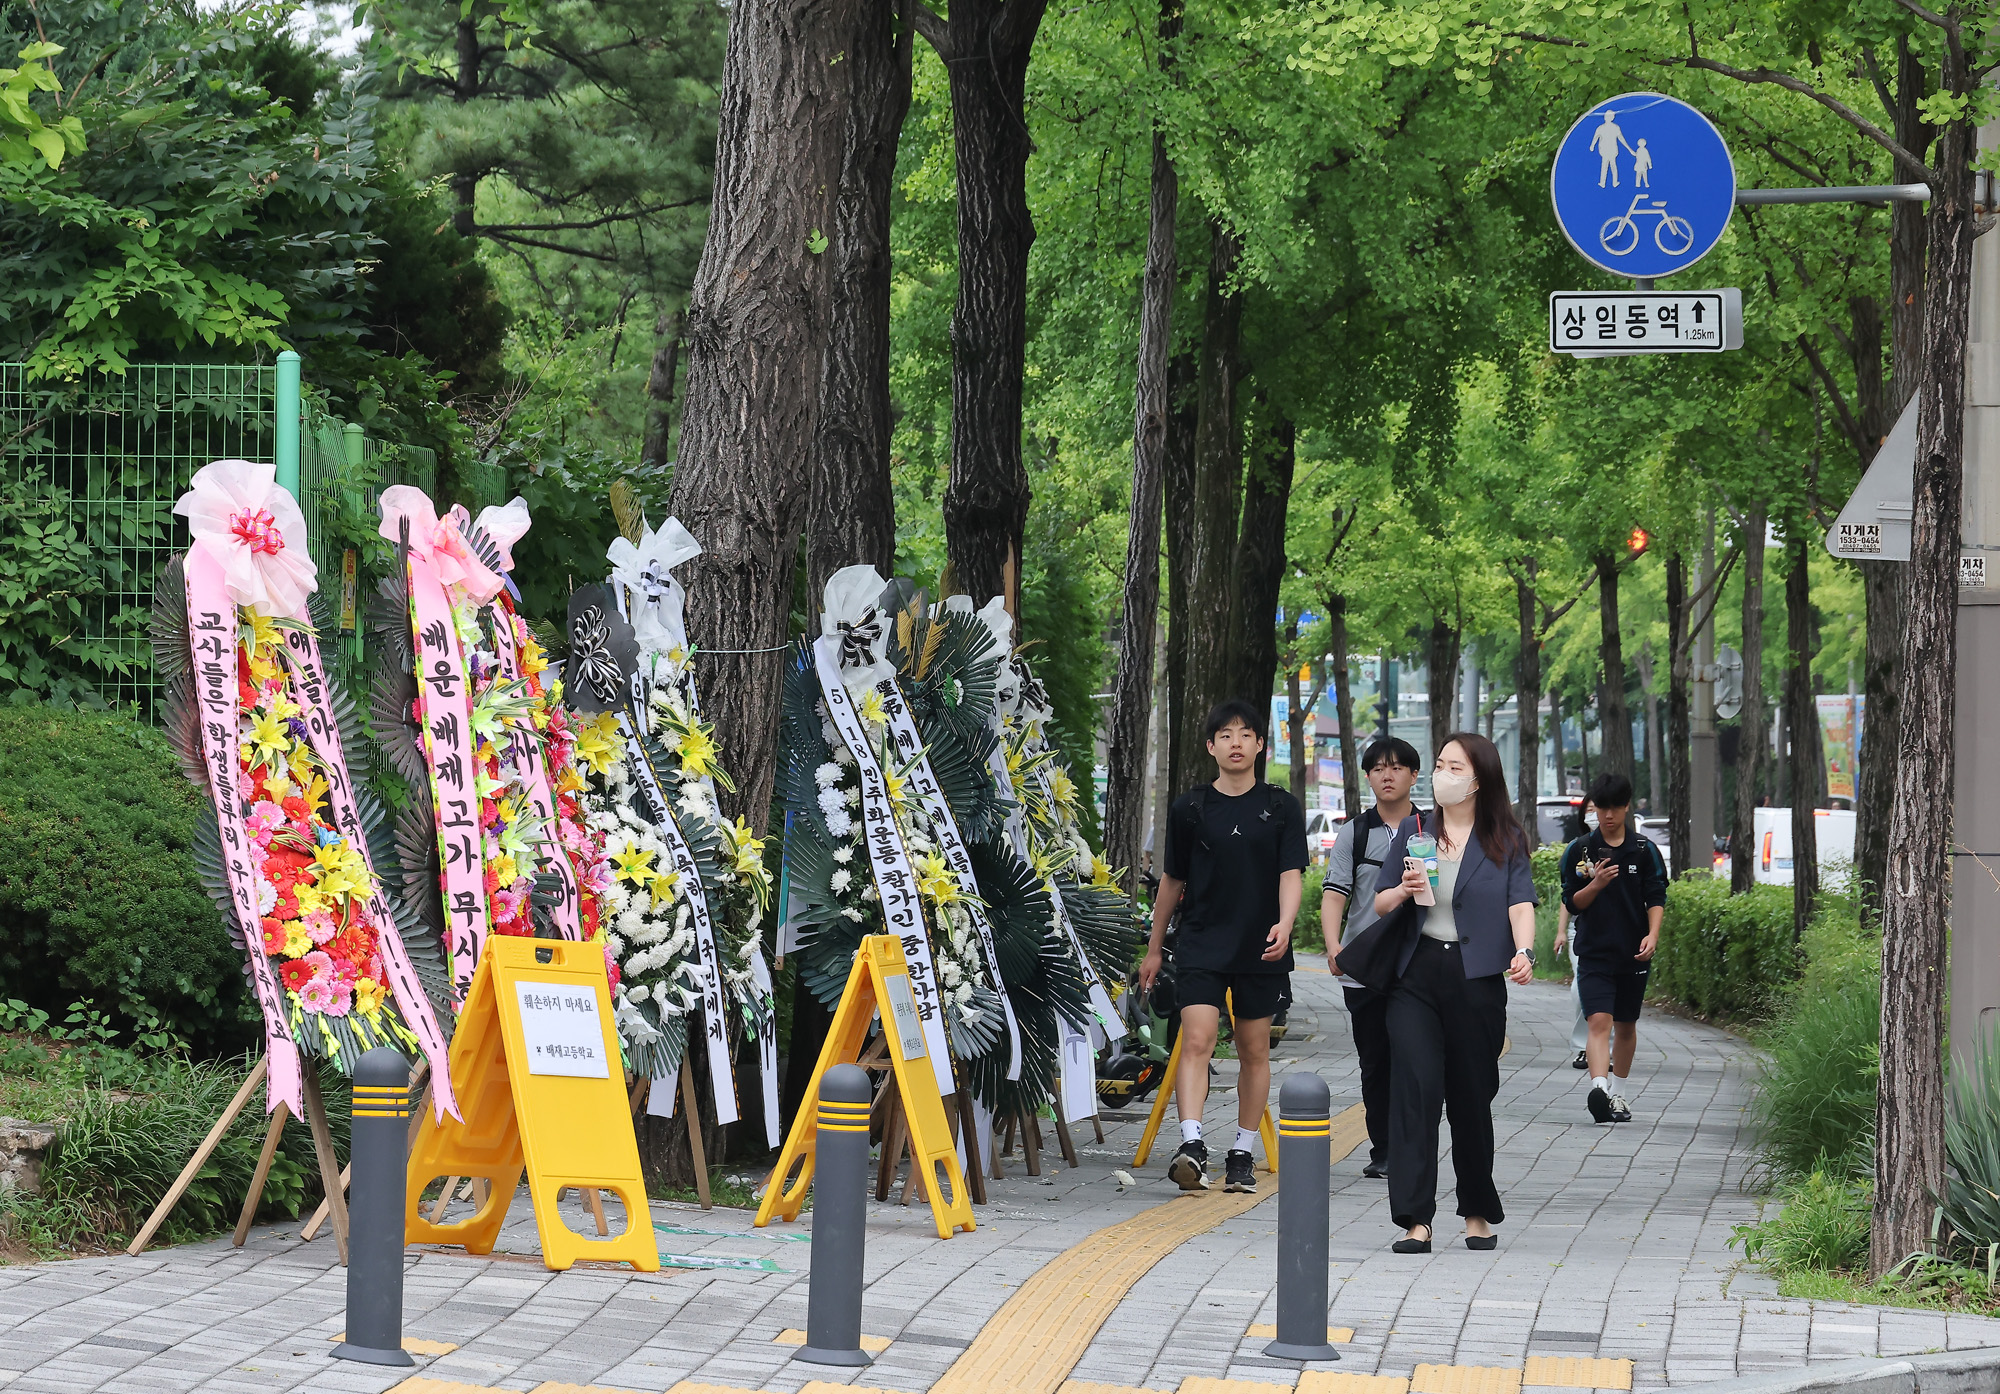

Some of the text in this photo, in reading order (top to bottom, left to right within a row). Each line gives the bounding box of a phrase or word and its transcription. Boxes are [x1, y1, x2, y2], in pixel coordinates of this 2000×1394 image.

[1562, 303, 1679, 340] 상일동역
[1684, 328, 1715, 341] 1.25km
[1840, 524, 1880, 536] 지게차
[1840, 536, 1880, 544] 1533-0454
[1961, 558, 1984, 570] 게차
[195, 612, 230, 714] 교사들은
[421, 619, 460, 698] 배운
[206, 720, 240, 851] 학생들부터
[430, 711, 478, 874] 배재고가
[862, 765, 901, 866] 민주화운동
[230, 859, 250, 911] 우선
[880, 869, 916, 928] 참가인
[524, 994, 594, 1013] 훼손하지 마세요
[701, 938, 723, 1043] 국민에게
[546, 1044, 595, 1060] 배재고등학교
